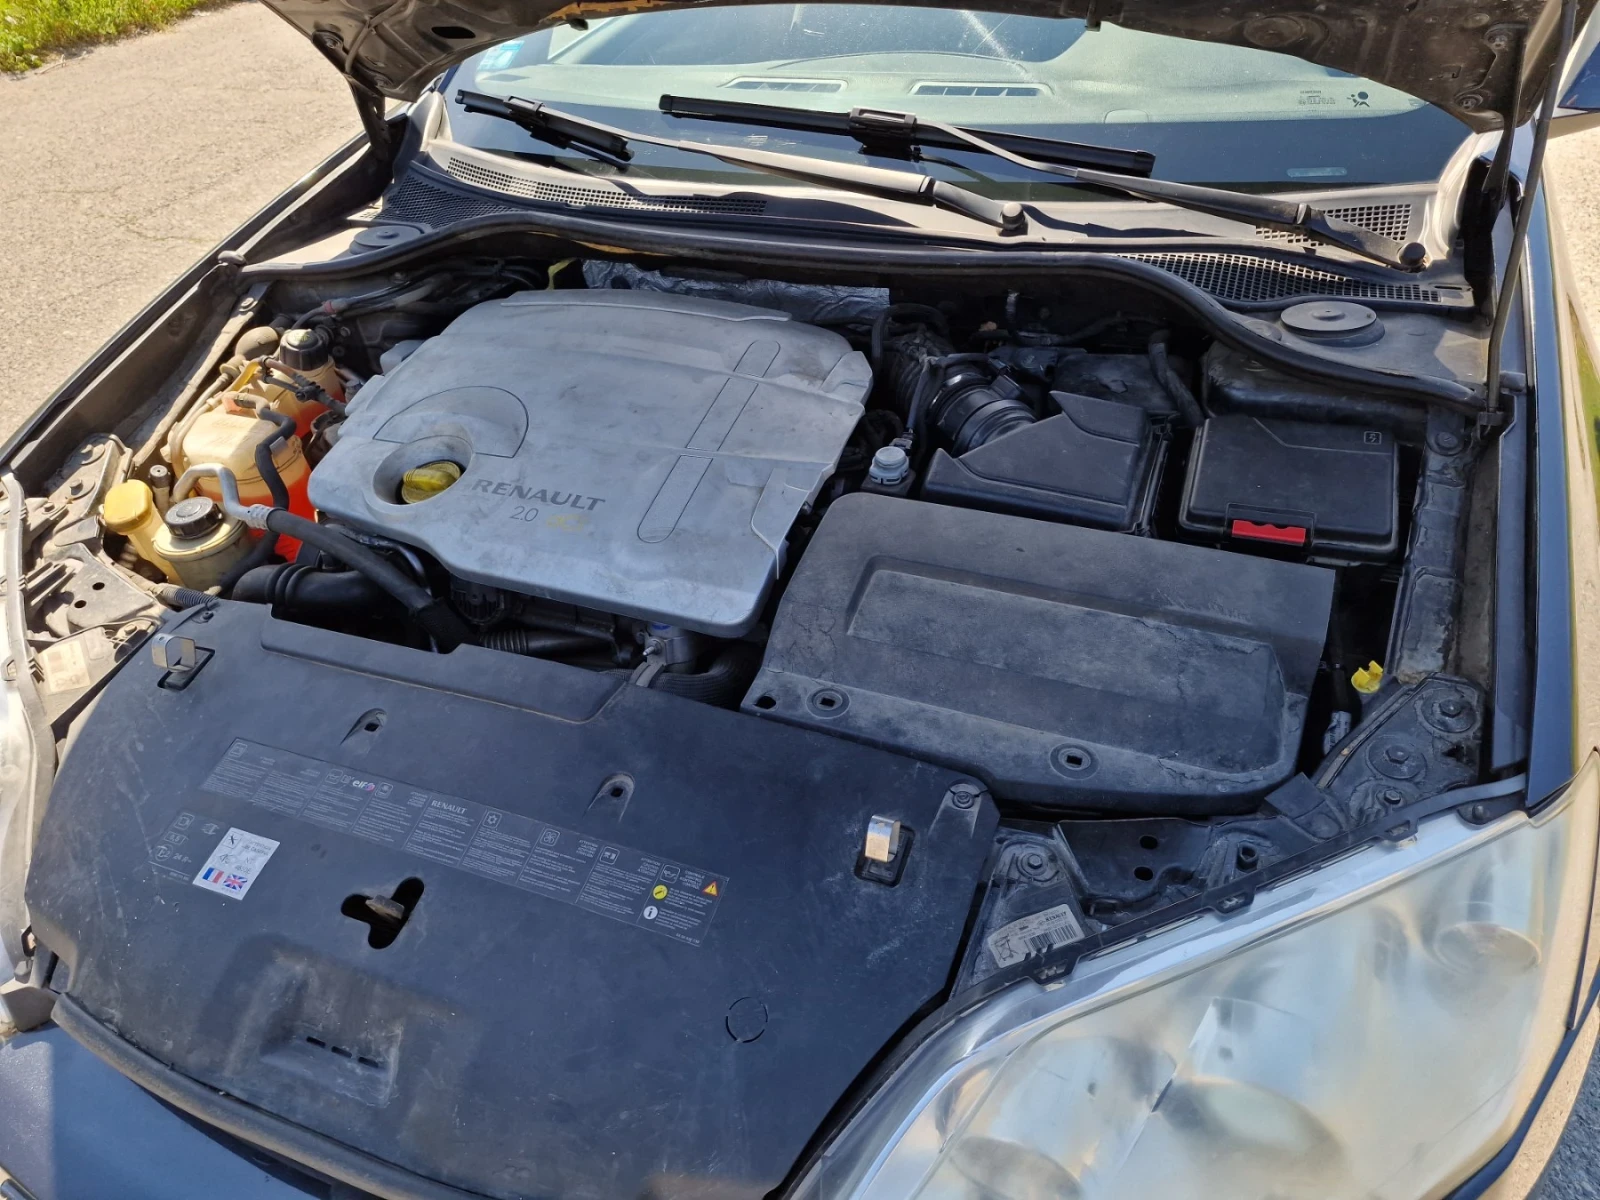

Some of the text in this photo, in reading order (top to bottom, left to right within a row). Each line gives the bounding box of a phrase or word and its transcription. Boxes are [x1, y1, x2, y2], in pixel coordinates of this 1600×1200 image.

[471, 478, 606, 512] RENAULT
[509, 505, 540, 523] 2.0
[431, 799, 468, 815] RENAULT
